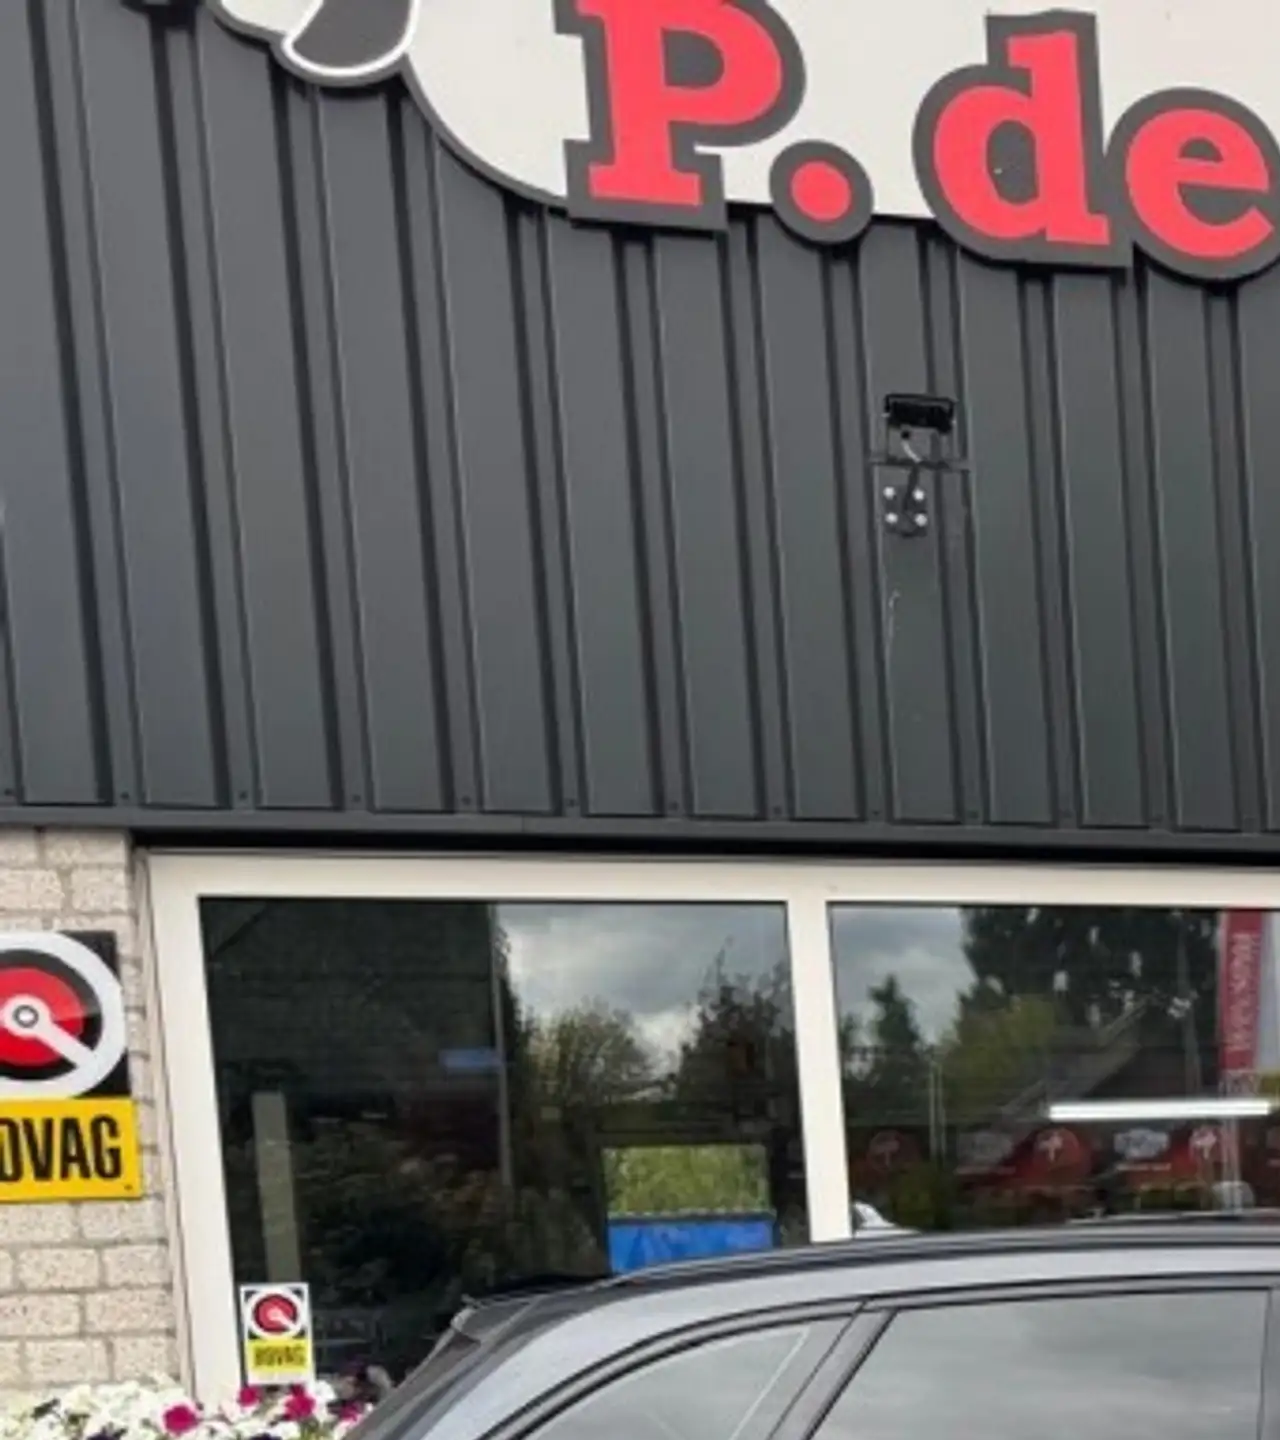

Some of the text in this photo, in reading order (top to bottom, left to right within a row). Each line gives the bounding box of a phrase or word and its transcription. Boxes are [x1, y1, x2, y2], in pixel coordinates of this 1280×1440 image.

[572, 0, 853, 222] P.
[930, 29, 1274, 260] de
[0, 1114, 122, 1183] OVAG
